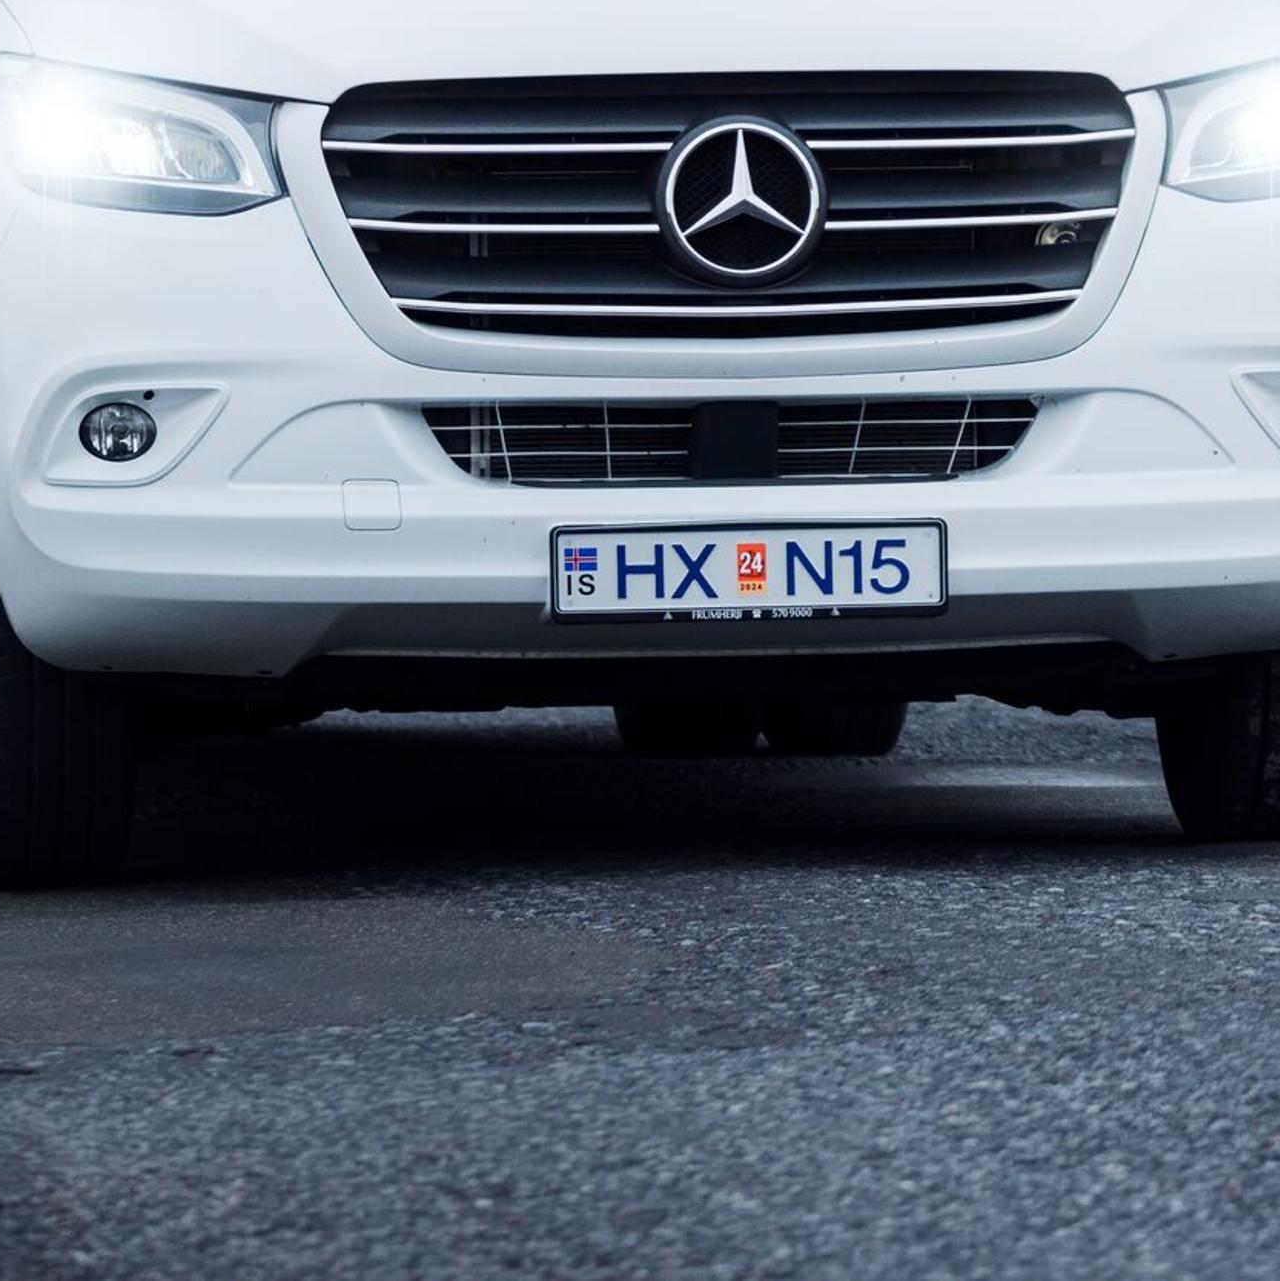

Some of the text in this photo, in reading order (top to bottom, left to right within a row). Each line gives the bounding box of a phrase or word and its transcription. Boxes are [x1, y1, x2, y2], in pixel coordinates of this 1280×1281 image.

[616, 539, 911, 600] HX N15
[739, 551, 764, 575] 24
[566, 574, 596, 596] IS
